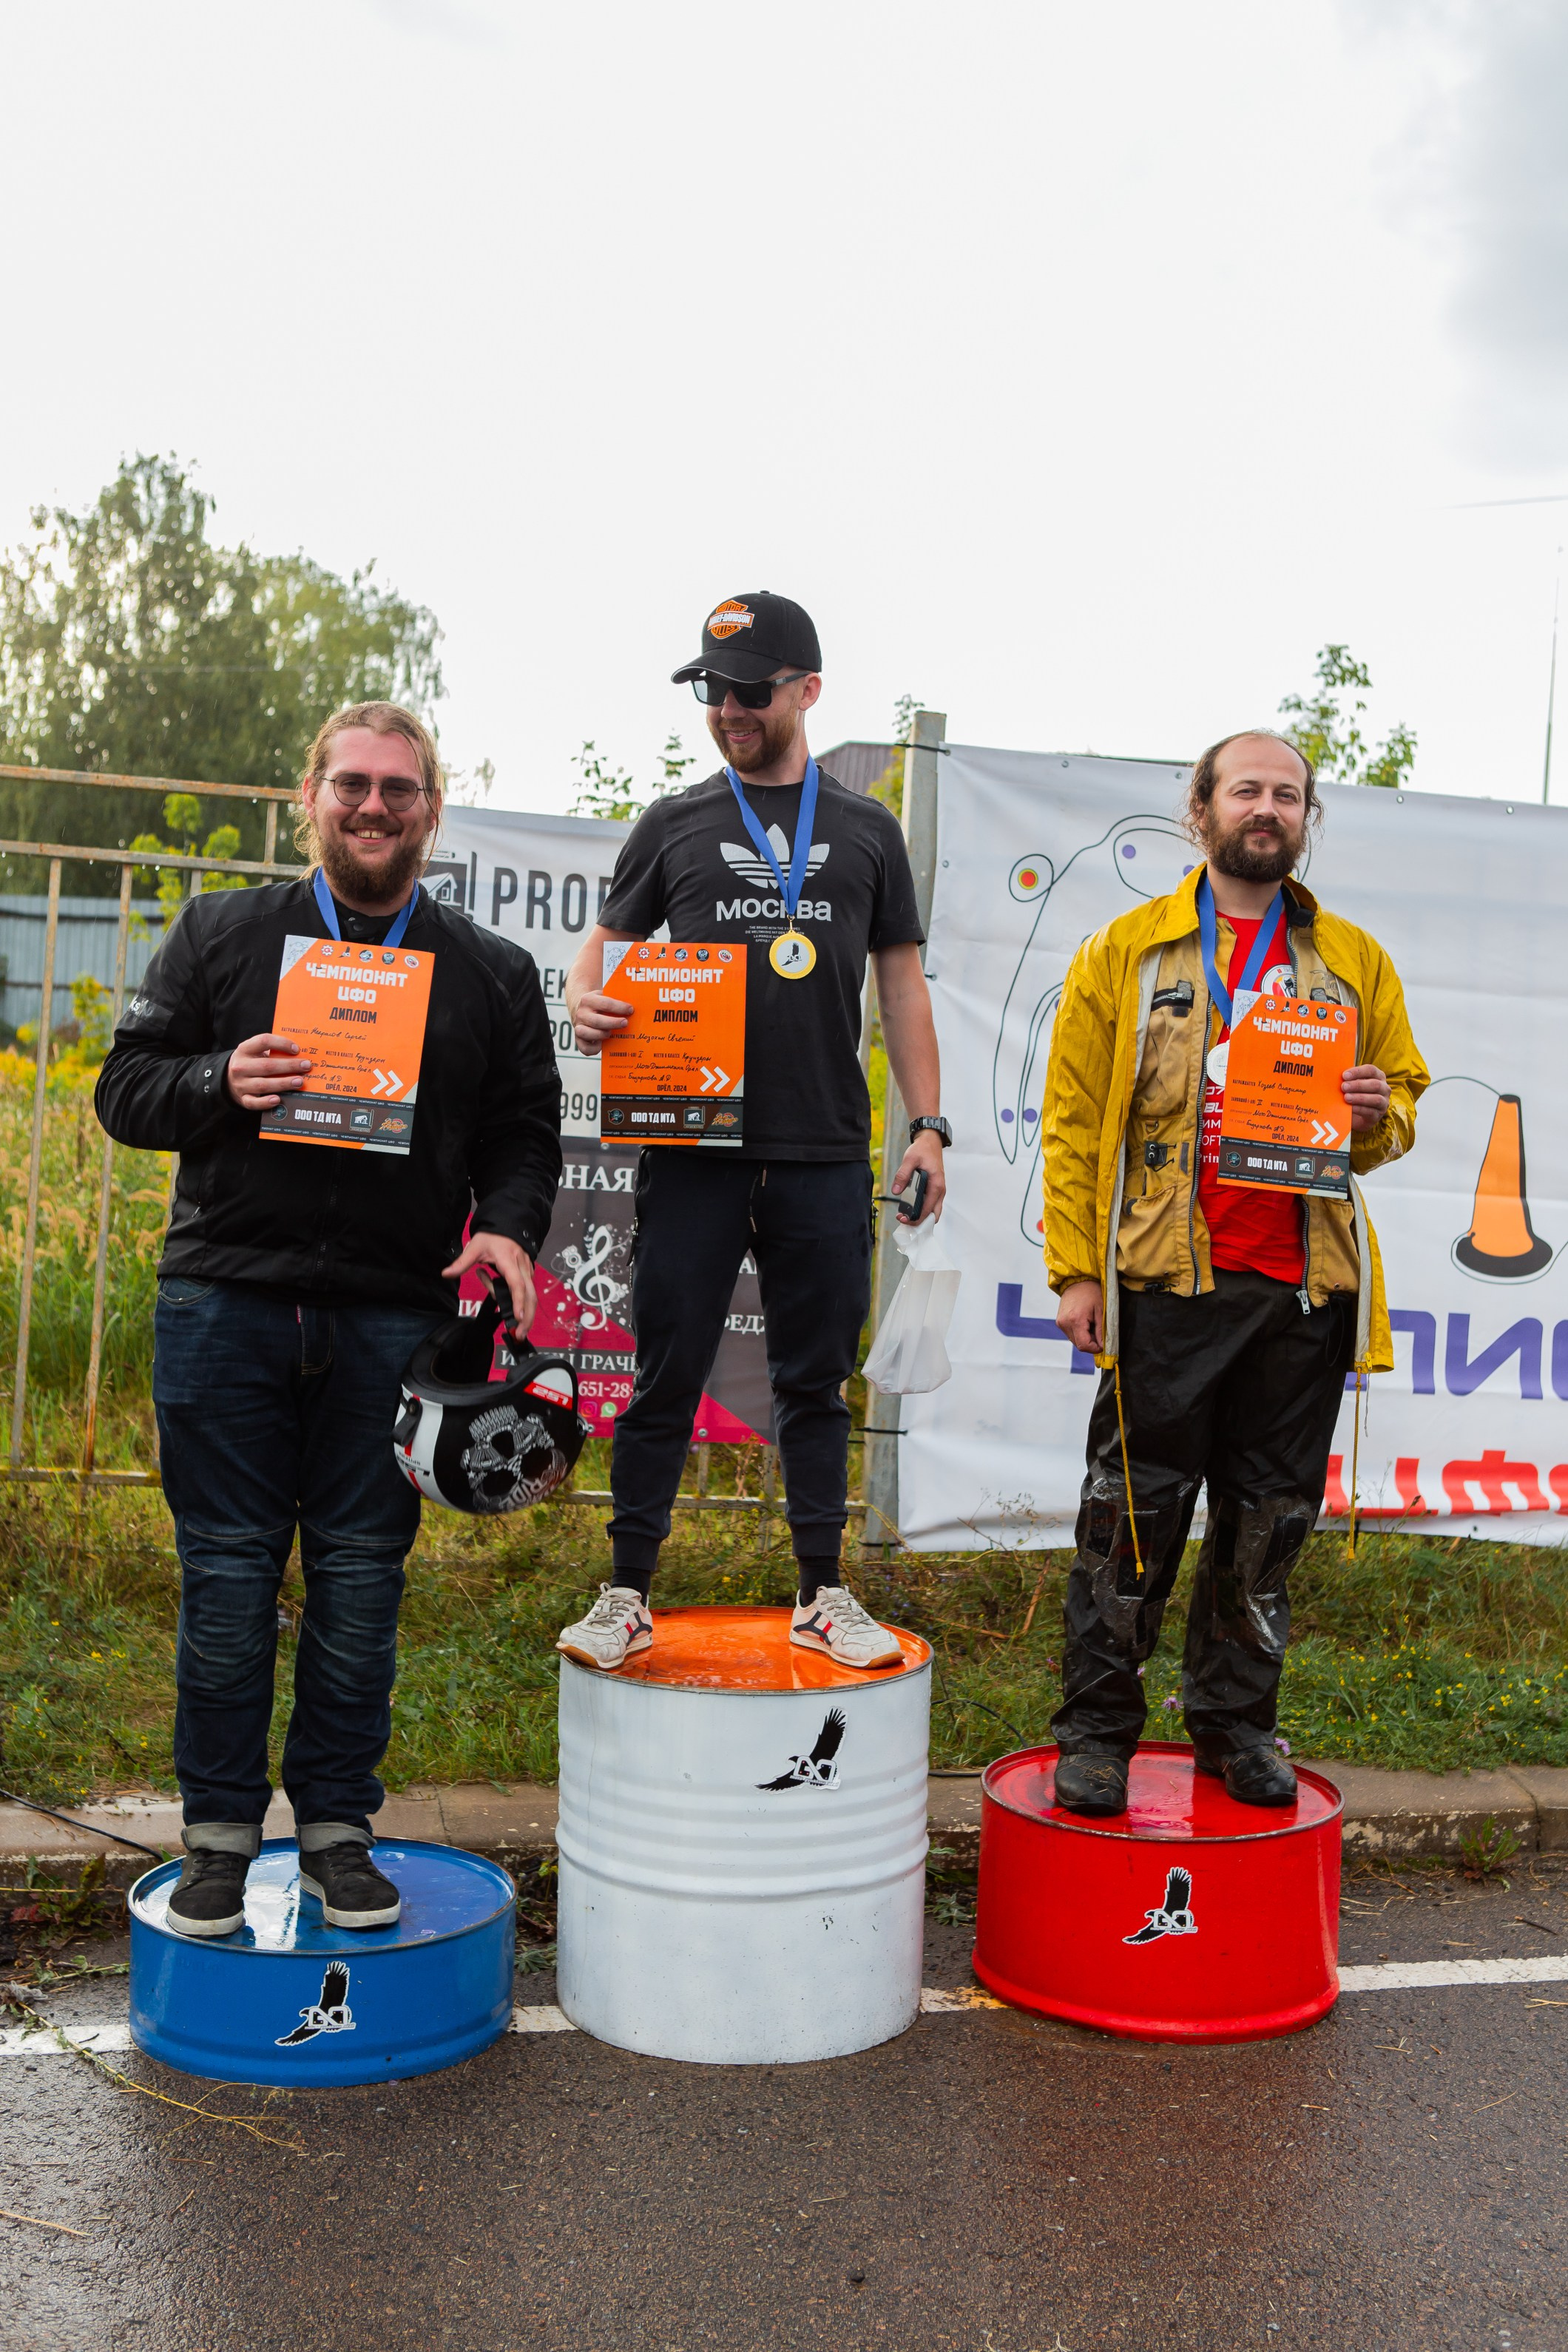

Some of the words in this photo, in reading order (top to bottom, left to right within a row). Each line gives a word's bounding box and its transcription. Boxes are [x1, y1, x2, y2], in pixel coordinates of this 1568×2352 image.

[306, 962, 408, 987] ЧЕМПИОНАТ
[626, 967, 723, 983] ЧЕМПИОНАТ
[338, 986, 377, 1004] ЦФО
[658, 988, 695, 1003] ЦФО
[329, 1007, 377, 1024] ДИПЛОМ
[653, 1009, 698, 1023] ДИПЛОМ
[1253, 1016, 1338, 1042] ЧЕМПИОНАТ
[1280, 1040, 1313, 1058] ЦФО
[1273, 1060, 1314, 1077] ДИПЛОМ
[295, 1109, 312, 1121] ООО
[313, 1111, 325, 1123] ТД
[325, 1112, 341, 1124] ИТА
[631, 1112, 647, 1122] ООО
[648, 1113, 659, 1123] ТД
[660, 1113, 675, 1123] ИТА
[1247, 1157, 1262, 1168] ООО
[1263, 1158, 1272, 1170] ТД
[1273, 1160, 1287, 1171] ИТА
[558, 1164, 635, 1192] НАЯ
